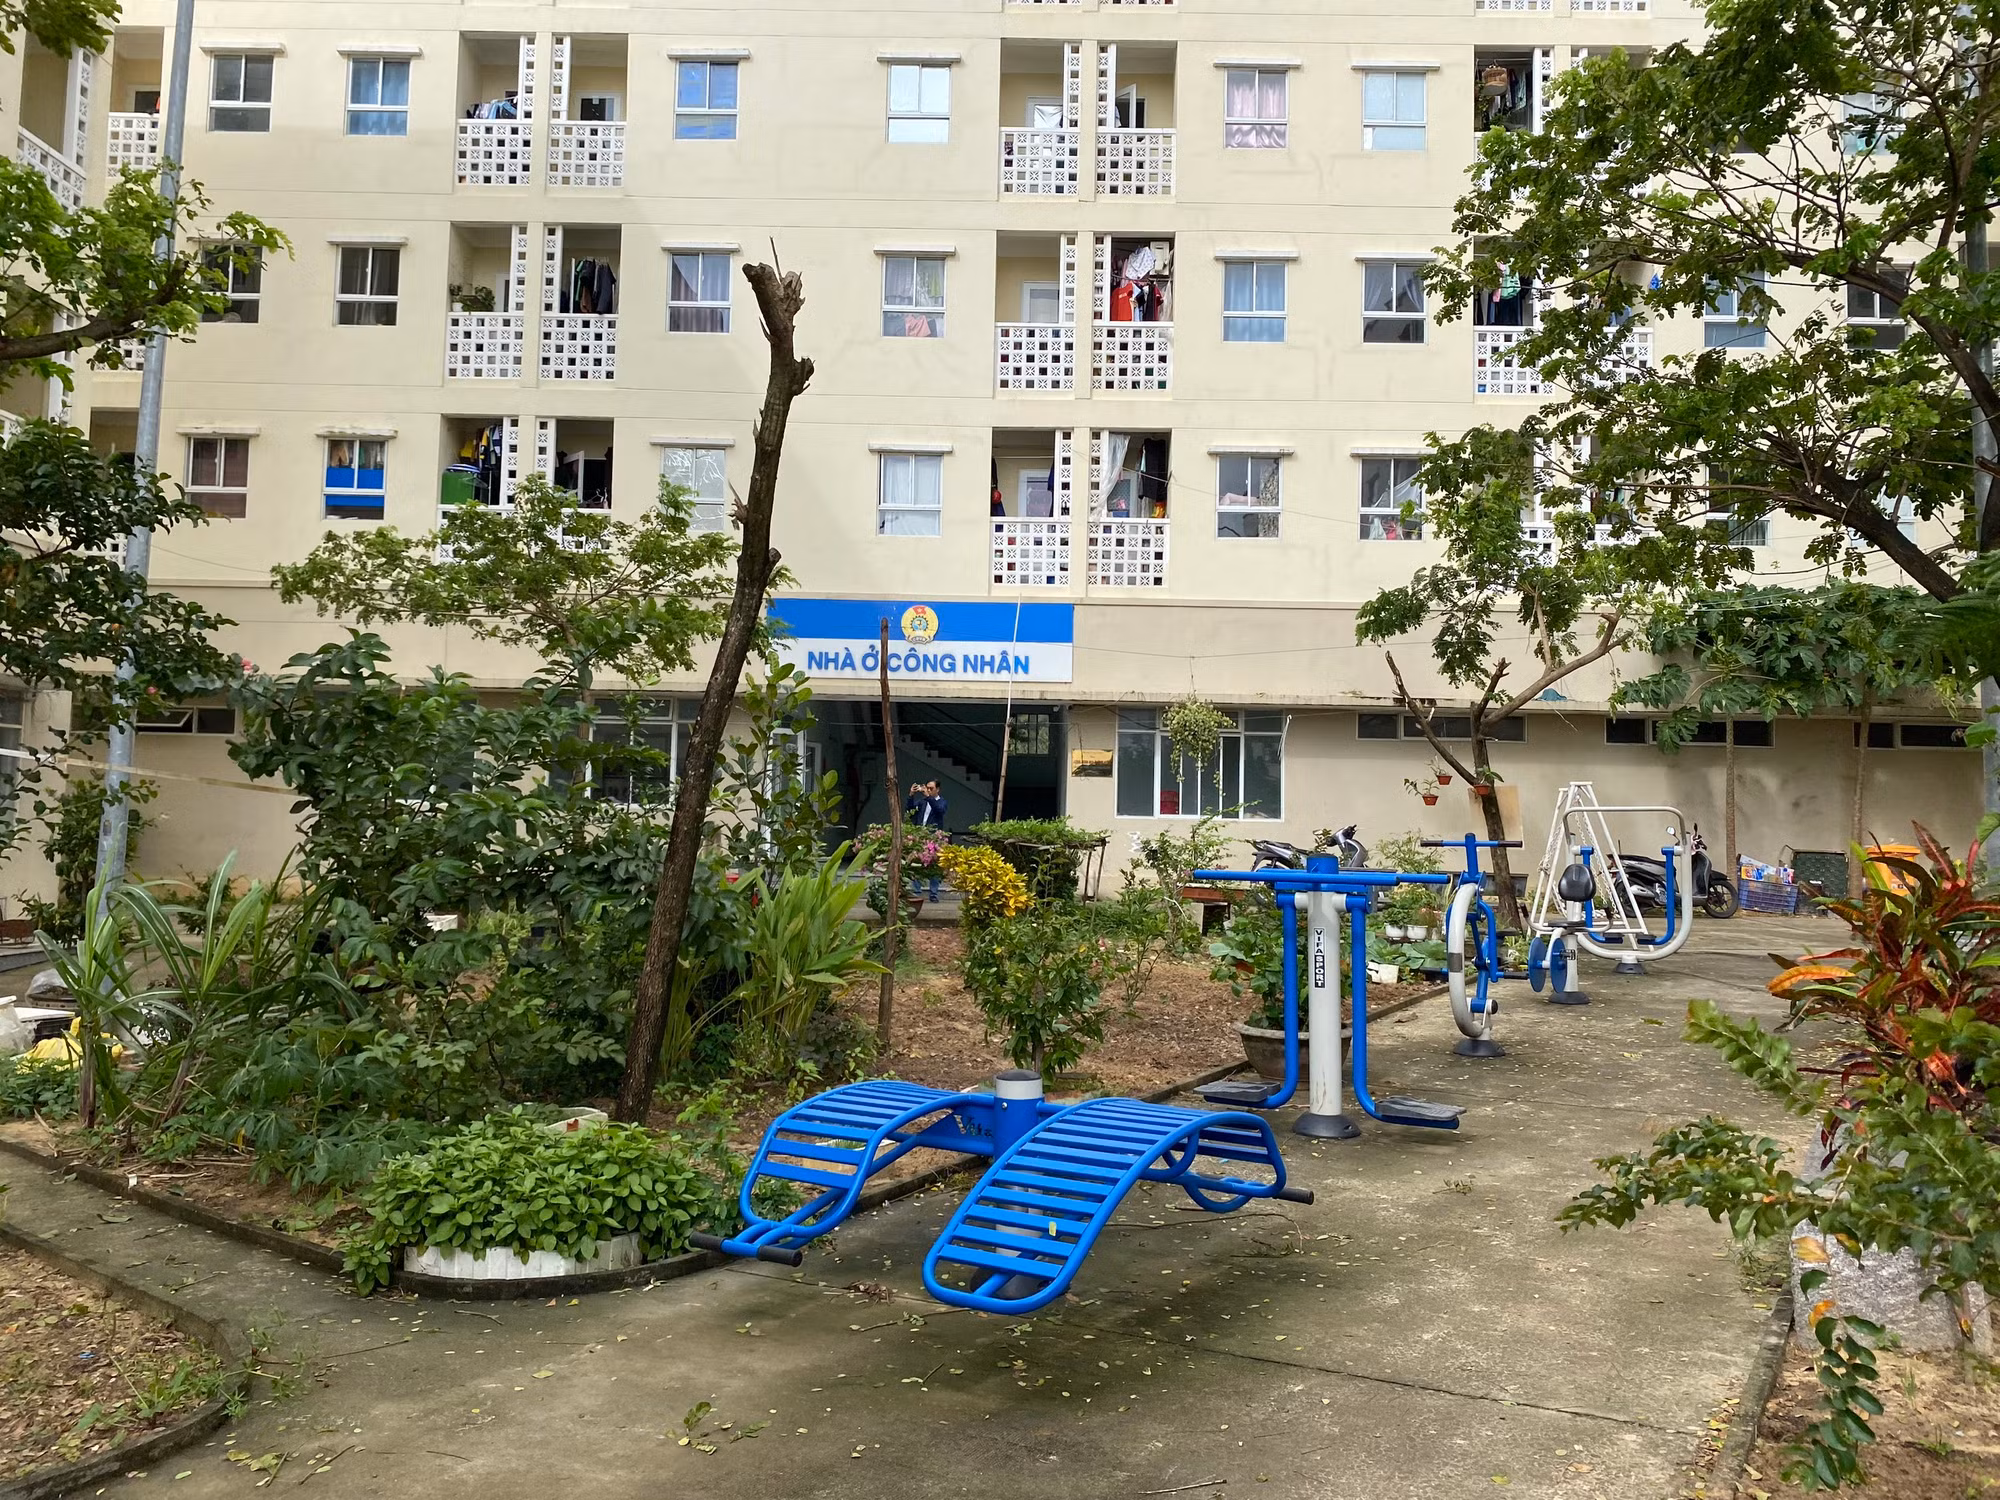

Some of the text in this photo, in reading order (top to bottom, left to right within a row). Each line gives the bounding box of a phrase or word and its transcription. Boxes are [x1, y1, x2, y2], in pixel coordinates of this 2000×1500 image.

[807, 644, 1030, 675] NHÀ Ở CÔNG NHÂN
